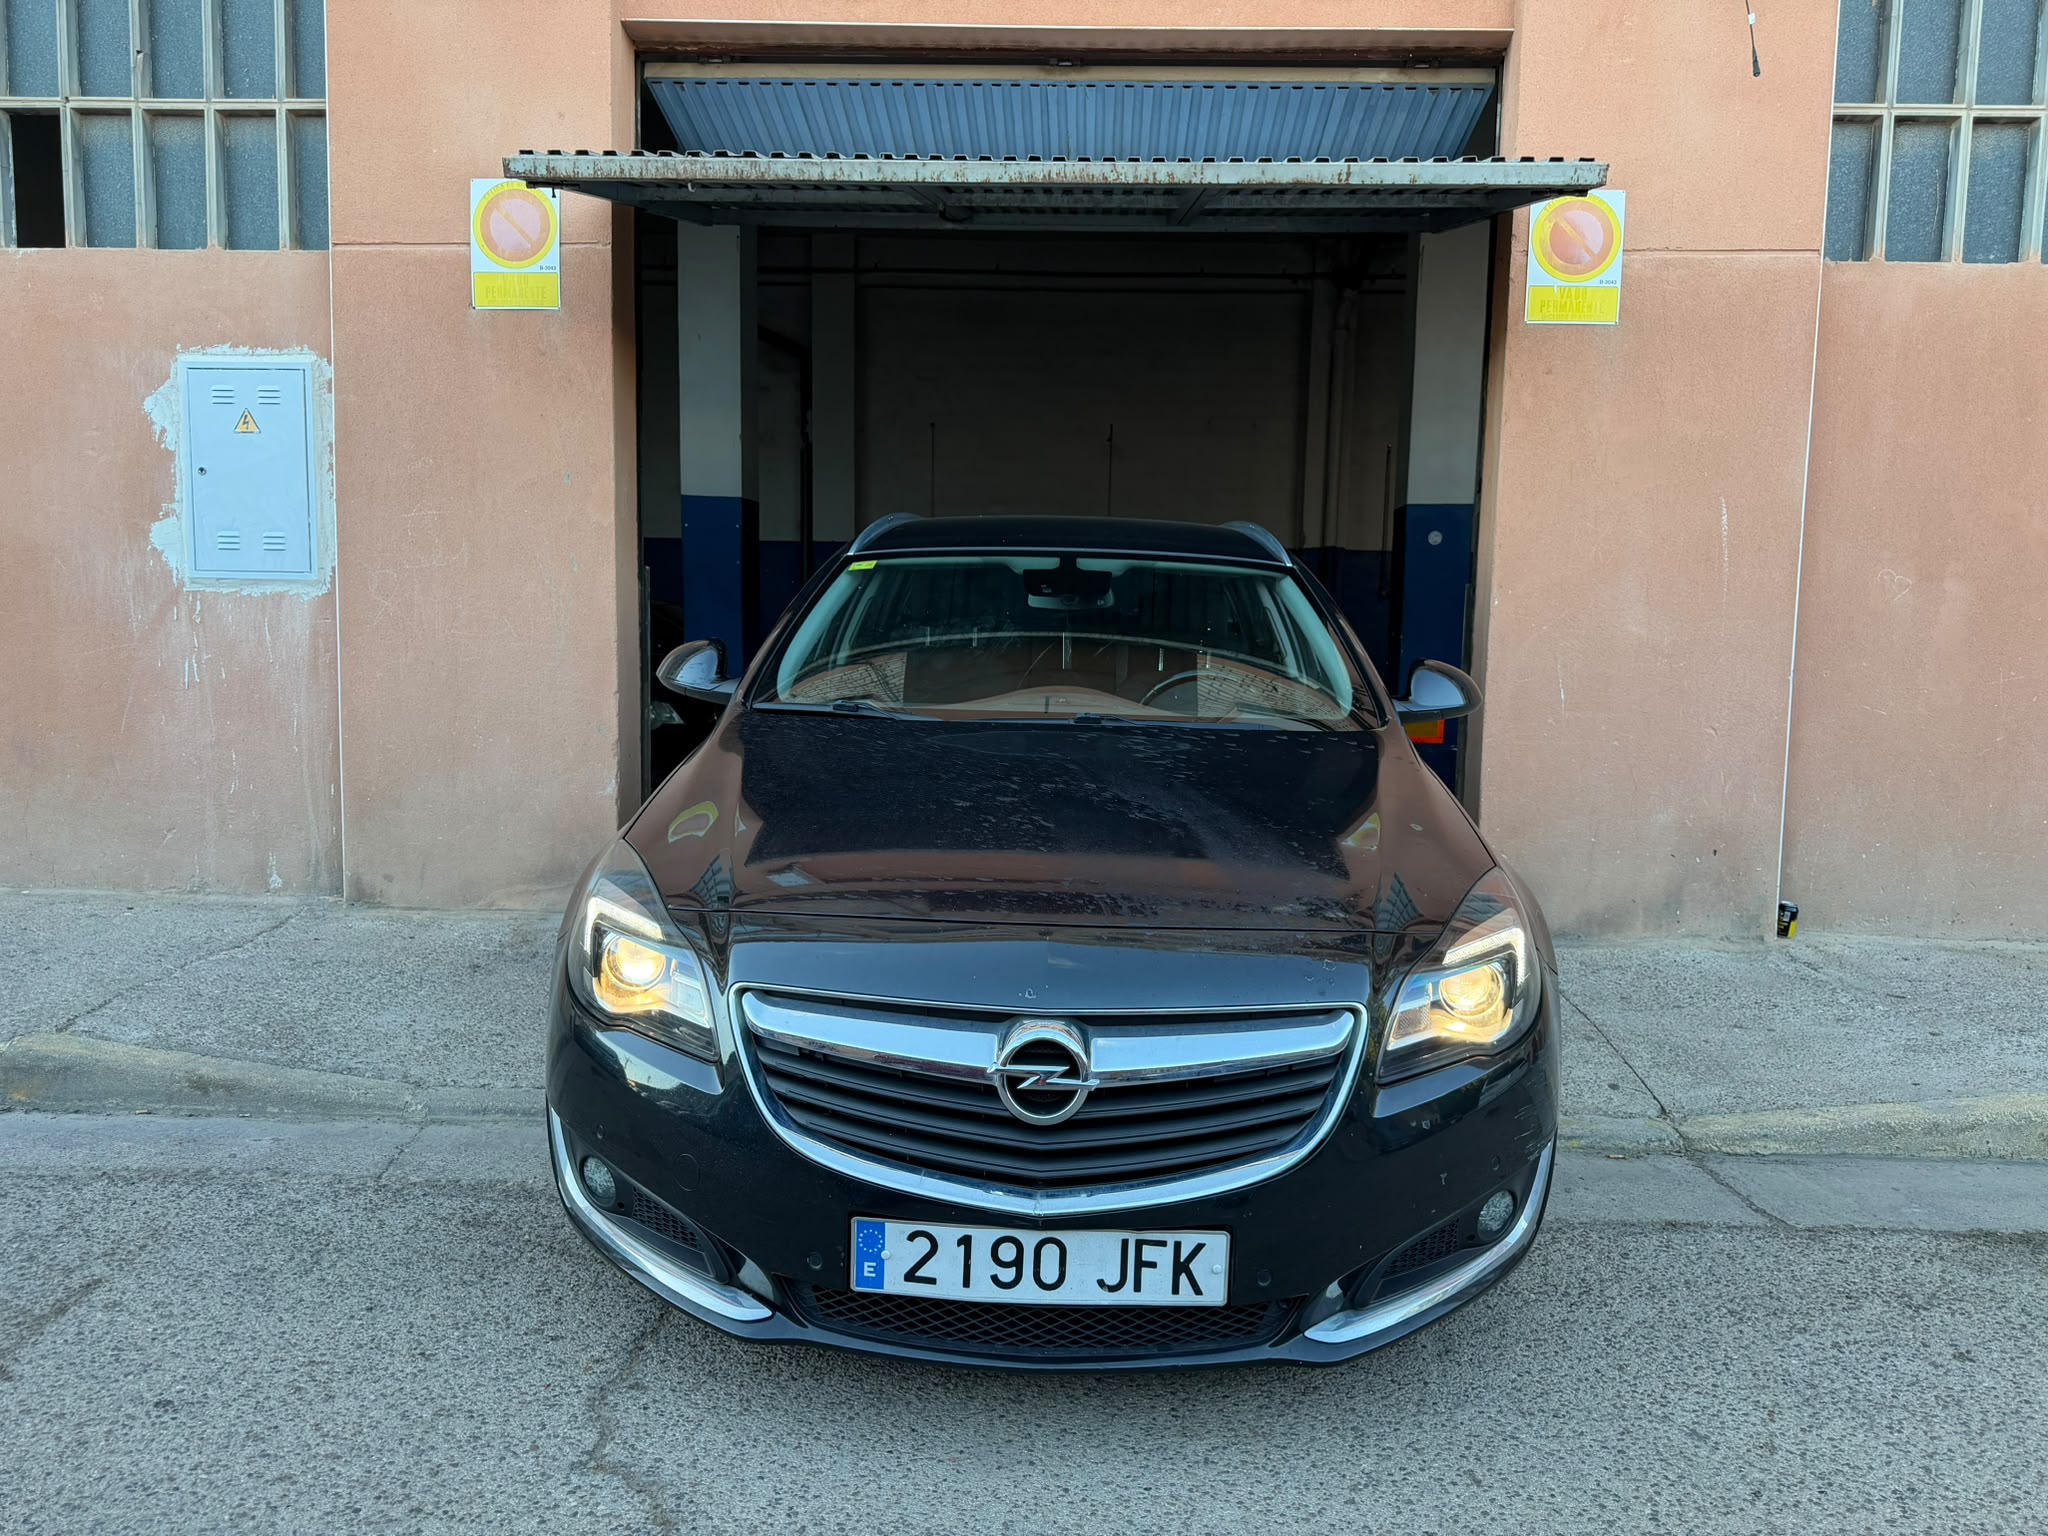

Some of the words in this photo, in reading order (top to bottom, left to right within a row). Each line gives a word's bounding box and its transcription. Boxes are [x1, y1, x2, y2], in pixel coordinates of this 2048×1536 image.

[1558, 287, 1588, 300] VADO
[1539, 299, 1605, 313] PERMANENTE
[864, 1261, 876, 1278] E
[903, 1229, 1067, 1292] 2190
[1096, 1237, 1207, 1297] JFK
